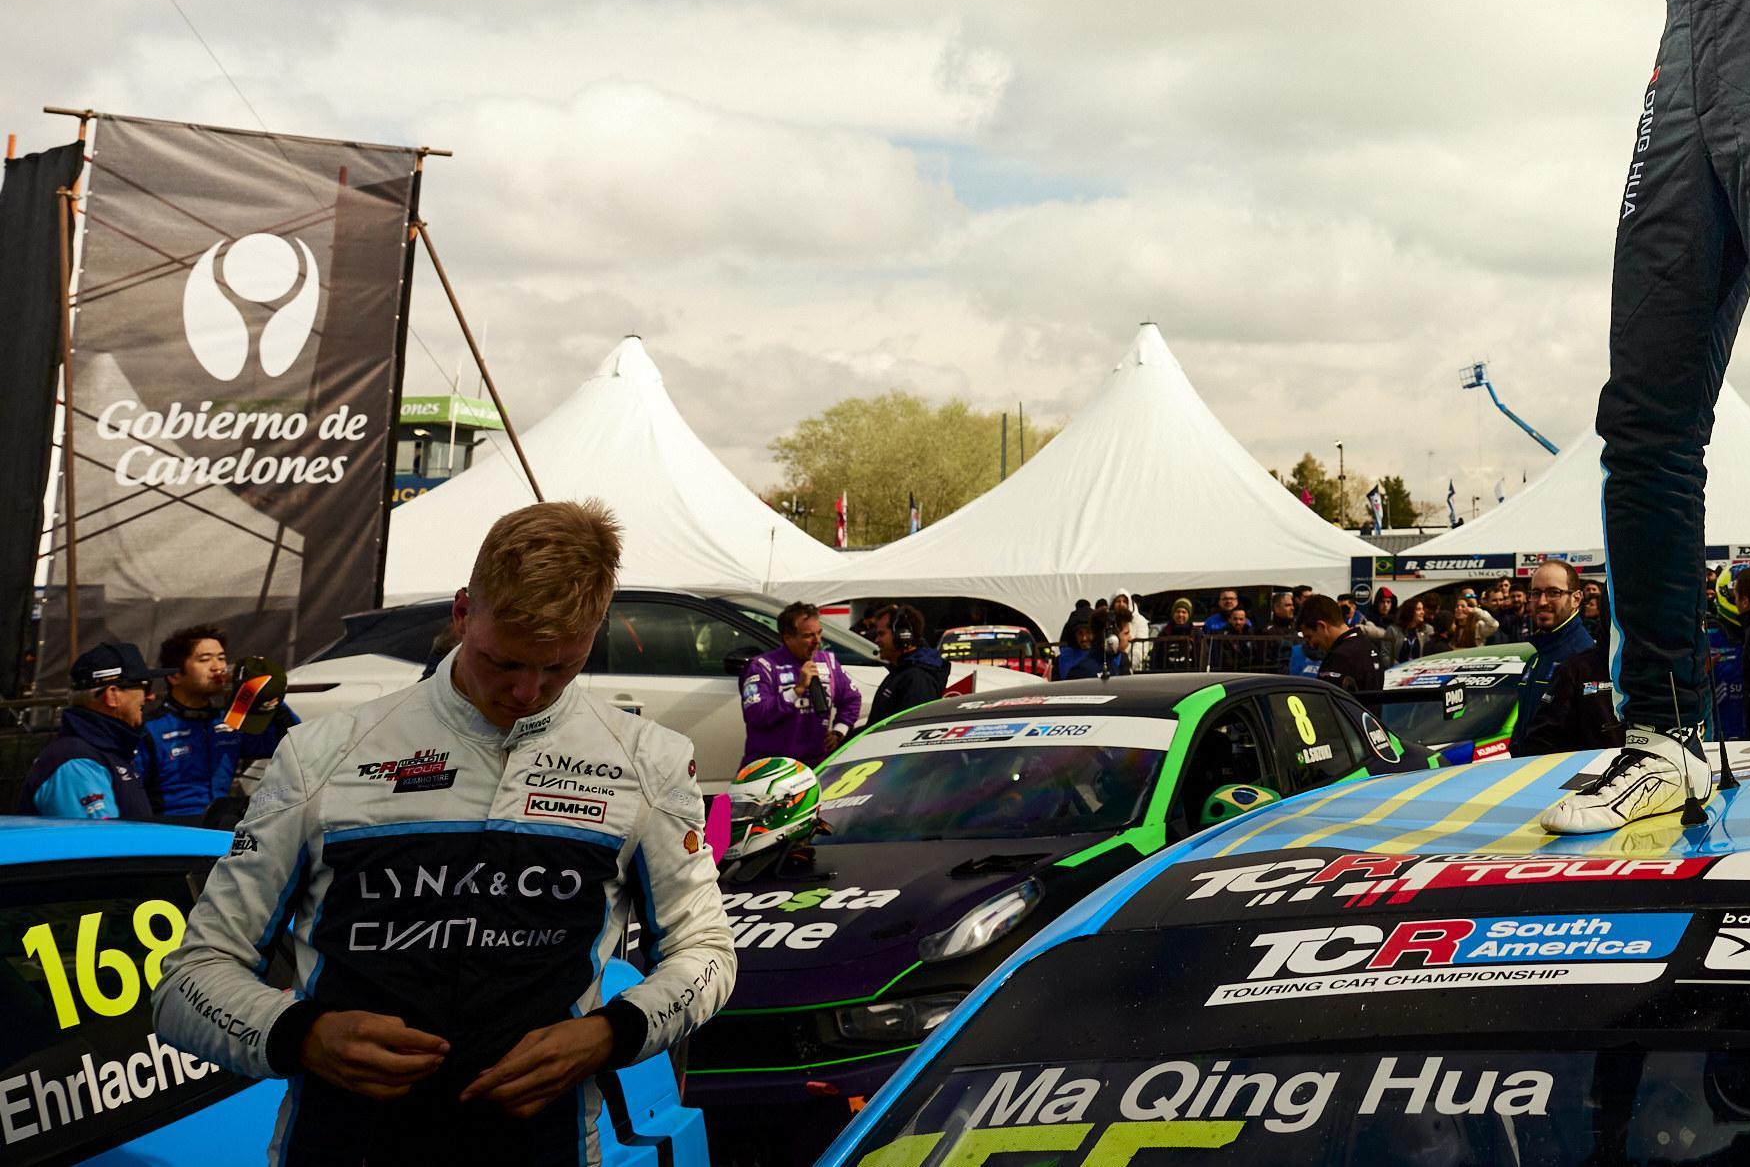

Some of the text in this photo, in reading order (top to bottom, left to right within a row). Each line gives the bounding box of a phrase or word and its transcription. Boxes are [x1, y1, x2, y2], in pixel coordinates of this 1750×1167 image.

[96, 400, 368, 440] Gobierno de
[115, 445, 348, 486] Canelones
[1425, 559, 1486, 570] SUZUKI
[1287, 695, 1317, 745] 8
[357, 761, 398, 777] TCR
[820, 760, 884, 801] 8
[578, 784, 615, 797] RACING
[530, 799, 602, 817] KUMHO
[1185, 854, 1421, 900] TCR
[1460, 859, 1686, 882] TOUR
[480, 929, 567, 947] RACING
[1486, 918, 1612, 938] South
[1247, 919, 1476, 980] TCR
[1466, 938, 1652, 958] America
[22, 899, 188, 1029] 168
[1222, 969, 1569, 999] TOURING CAR CHAMPIONSHIP
[966, 1056, 1554, 1132] Ma Qing Hua
